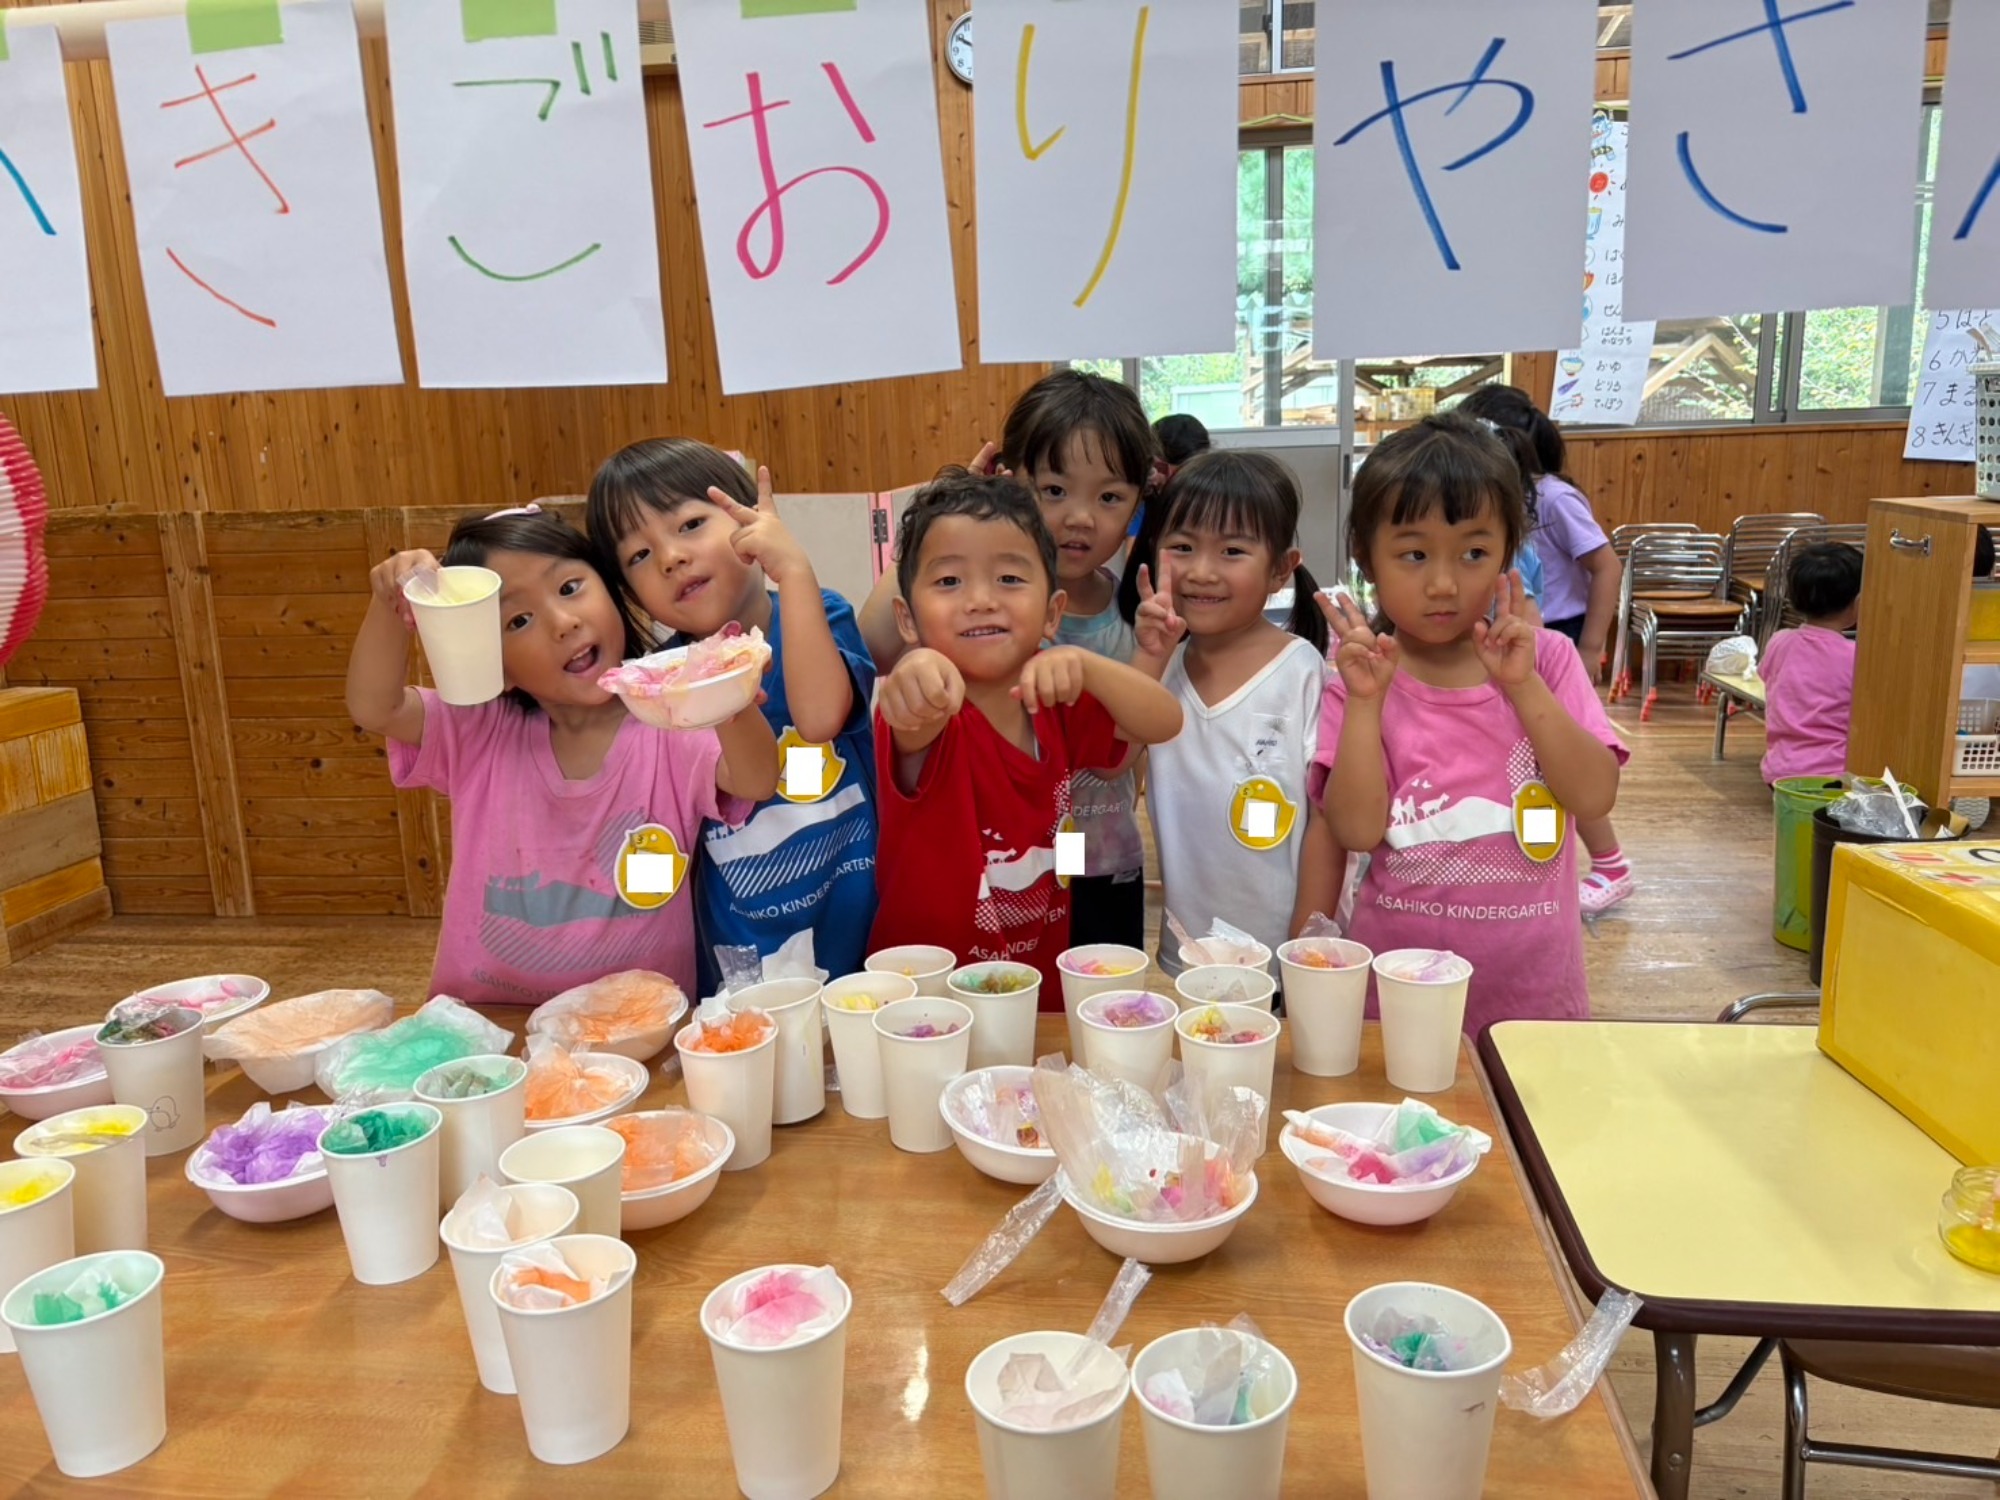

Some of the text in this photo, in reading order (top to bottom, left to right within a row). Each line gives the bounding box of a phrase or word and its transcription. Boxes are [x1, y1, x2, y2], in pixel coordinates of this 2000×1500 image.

[952, 46, 960, 56] 9
[957, 58, 965, 68] 8
[1936, 310, 1950, 331] 5
[1596, 360, 1622, 374] おゆ
[1929, 350, 1942, 371] 6
[1923, 381, 1937, 405] 7
[1911, 425, 1926, 448] 8
[1375, 893, 1560, 920] ASAHIKO KINDERGARTEN
[471, 966, 533, 998] ASAHIKO
